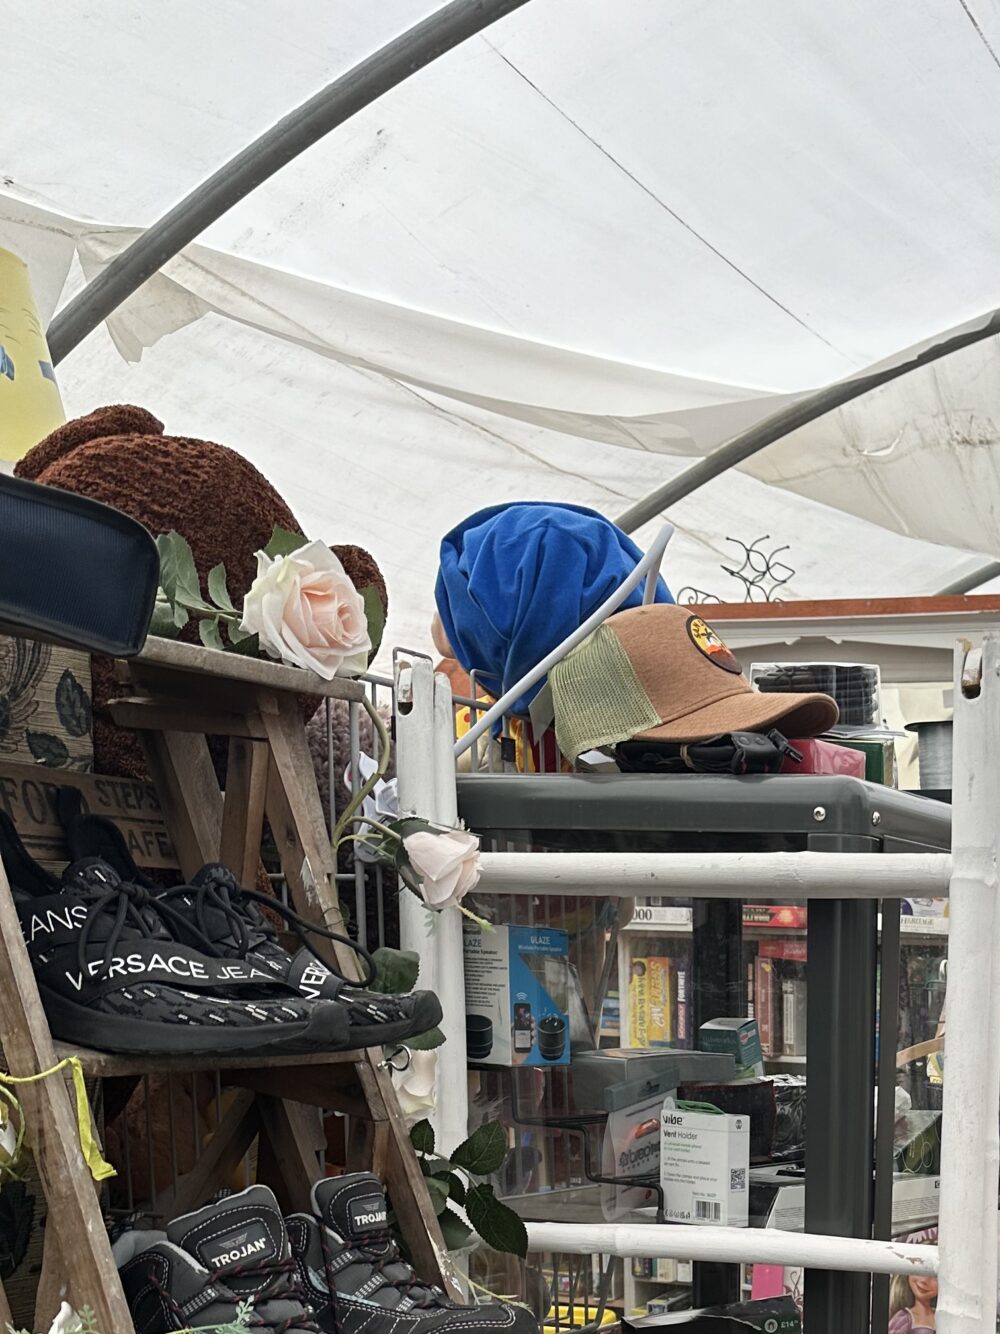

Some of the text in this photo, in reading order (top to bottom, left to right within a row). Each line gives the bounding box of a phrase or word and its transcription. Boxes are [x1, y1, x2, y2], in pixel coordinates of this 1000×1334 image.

[127, 829, 175, 859] AFE
[464, 938, 481, 947] LAZE
[530, 935, 551, 945] GLAZE
[65, 953, 277, 991] VERSACE JEA
[662, 1114, 683, 1126] vibe
[664, 1130, 698, 1140] Vent Holder
[354, 1211, 386, 1227] TROJAN
[211, 1236, 265, 1270] TROJAN
